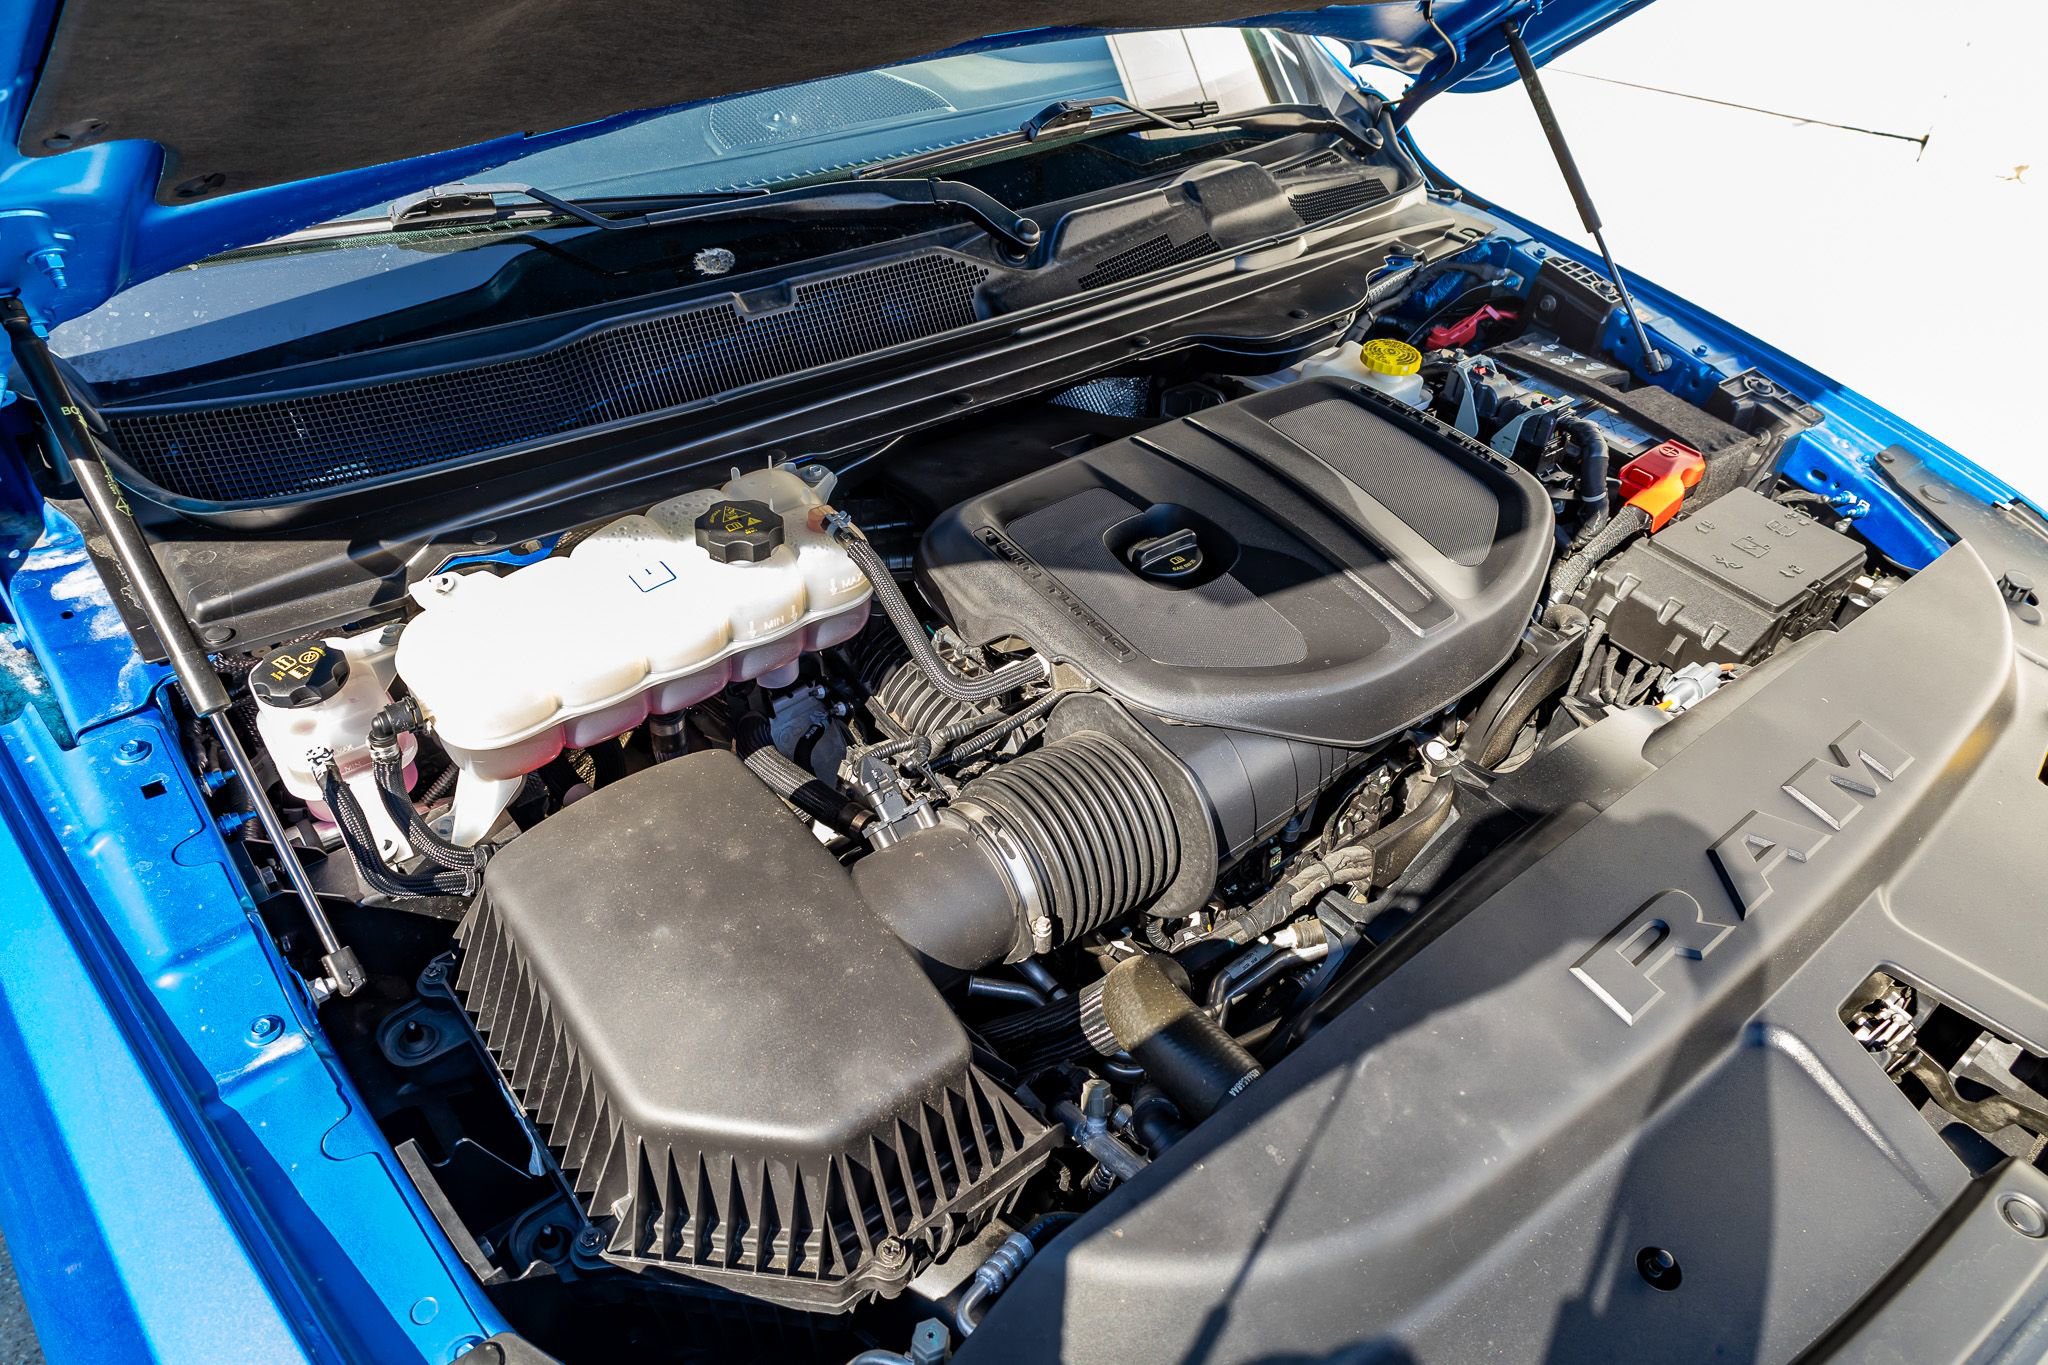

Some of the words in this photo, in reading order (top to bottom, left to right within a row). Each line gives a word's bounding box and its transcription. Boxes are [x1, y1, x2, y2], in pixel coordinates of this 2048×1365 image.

[764, 615, 785, 630] MIN
[1047, 578, 1131, 657] TURBO
[1569, 719, 1916, 1027] RAM
